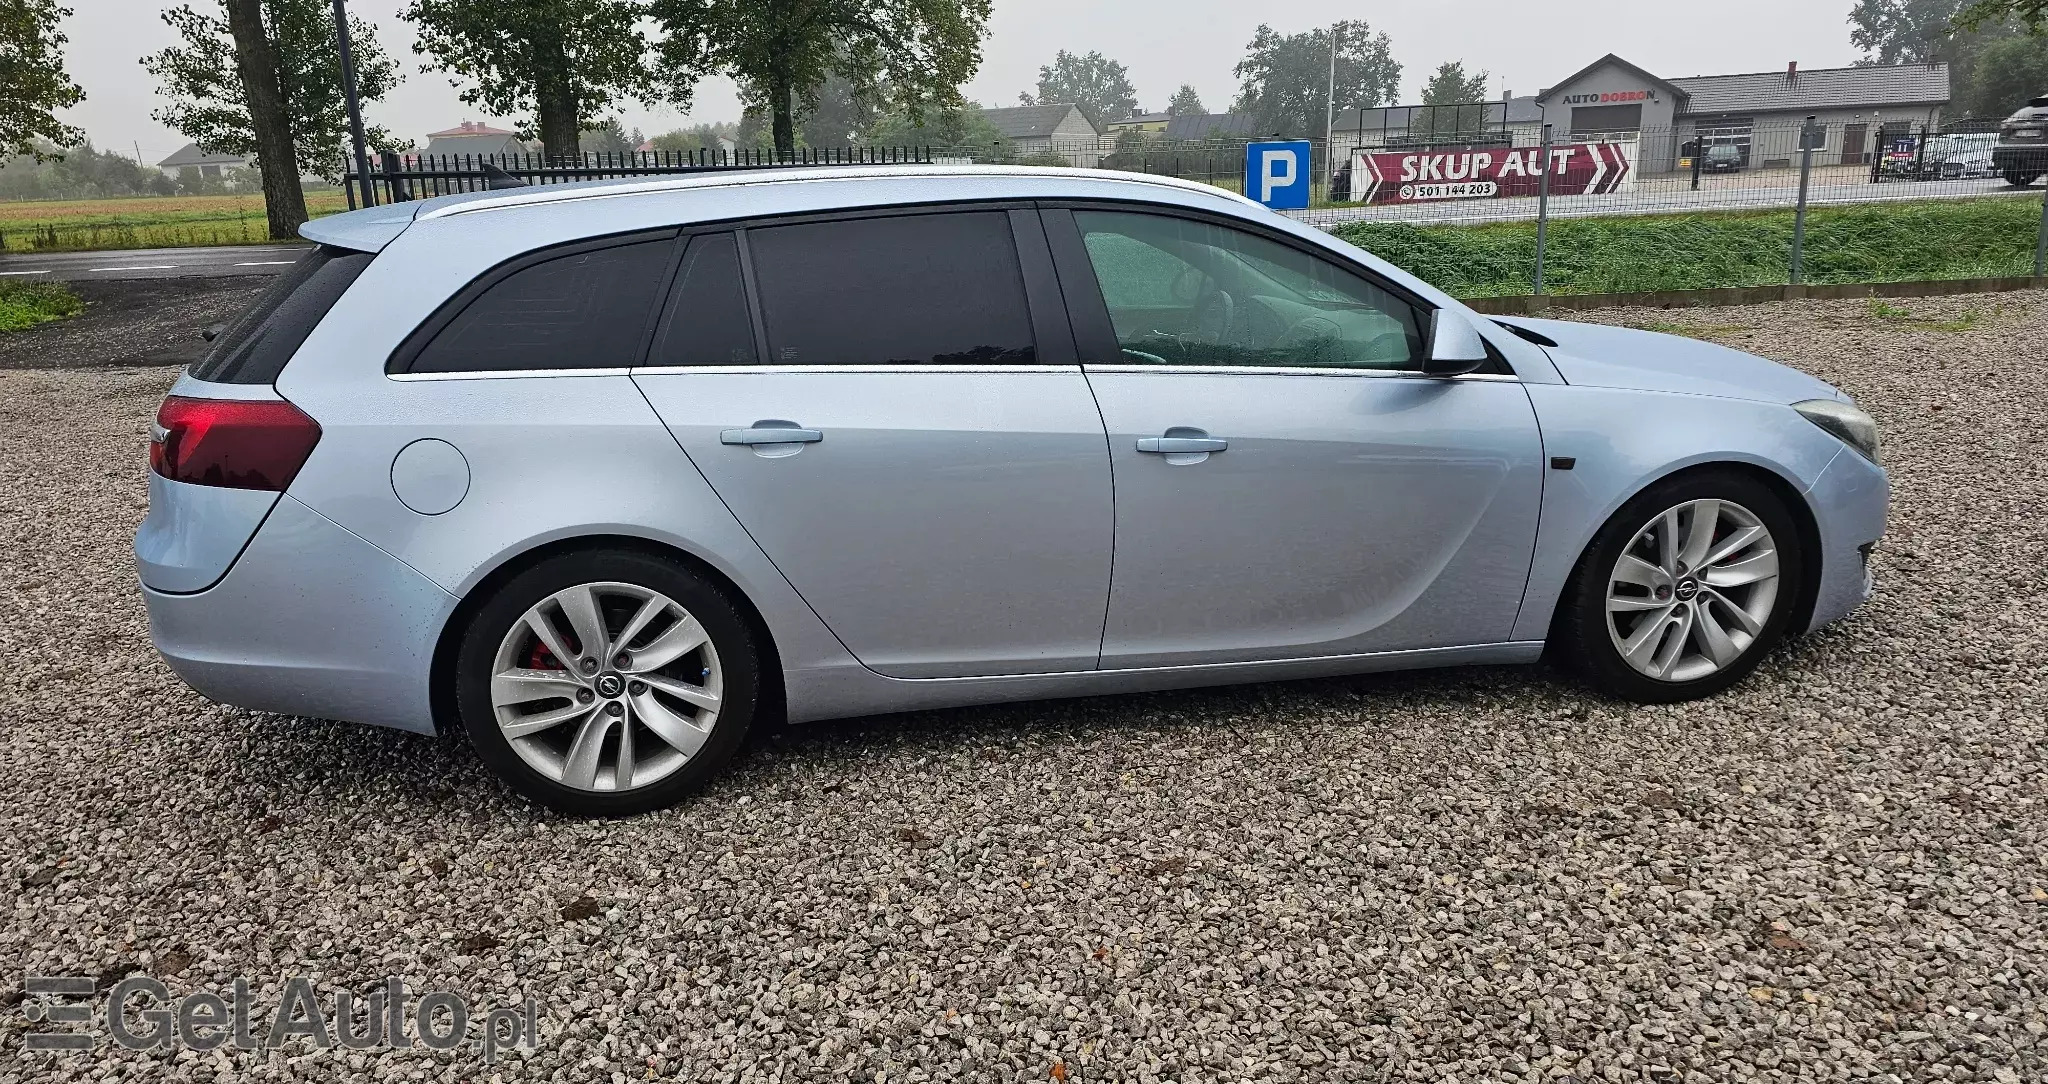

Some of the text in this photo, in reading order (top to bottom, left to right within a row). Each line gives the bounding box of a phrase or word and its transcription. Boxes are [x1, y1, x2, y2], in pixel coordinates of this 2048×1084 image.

[1562, 94, 1599, 104] AUTO
[1262, 150, 1296, 202] P
[1401, 148, 1575, 182] SKUP AUT
[1419, 184, 1491, 196] 501 144 203
